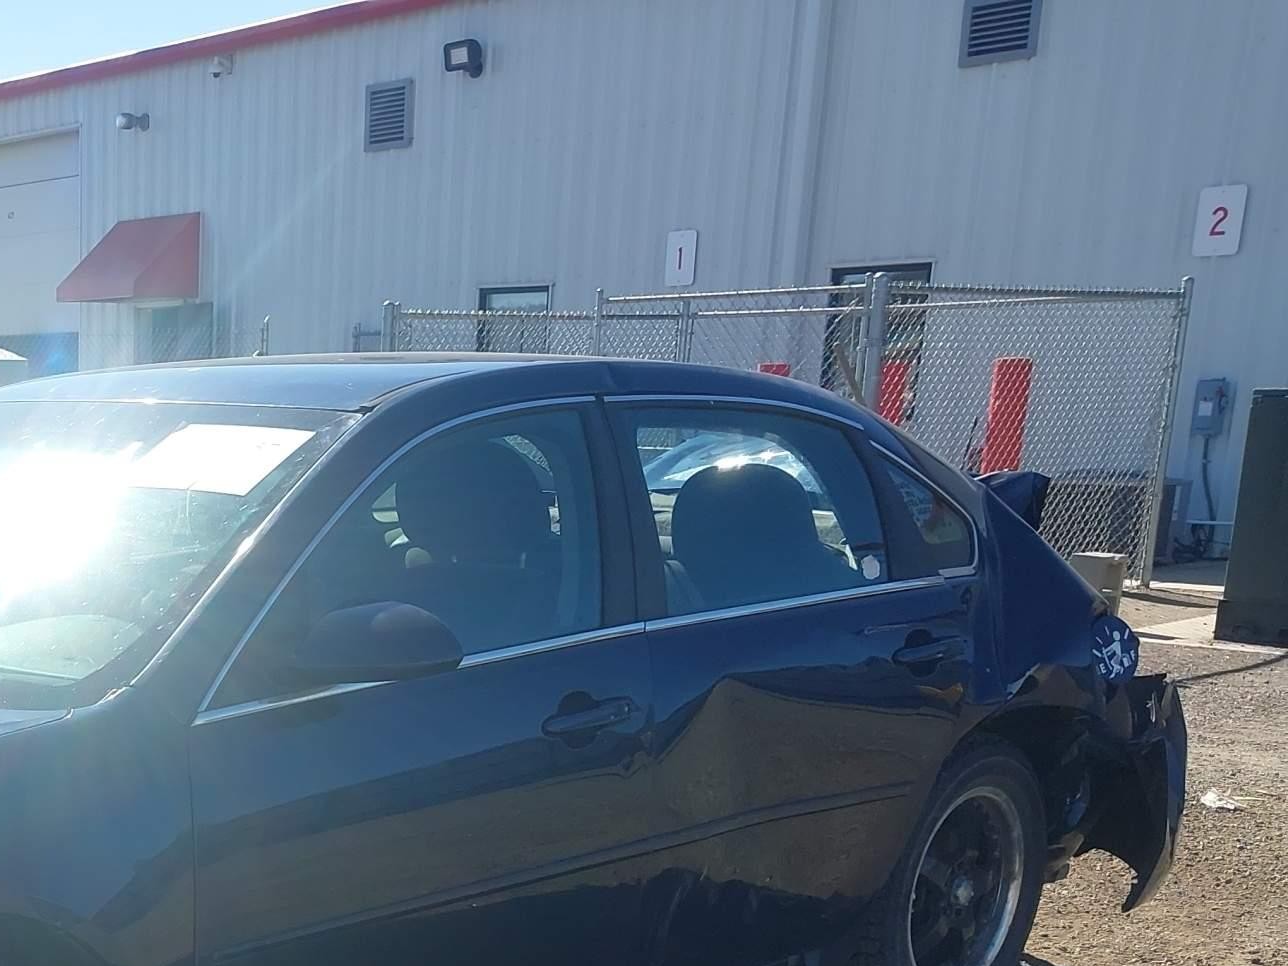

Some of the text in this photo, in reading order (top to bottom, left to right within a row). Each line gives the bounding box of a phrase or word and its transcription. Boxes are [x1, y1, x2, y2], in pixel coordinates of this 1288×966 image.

[1209, 206, 1229, 236] 2
[678, 246, 683, 270] 1
[1099, 663, 1107, 674] E
